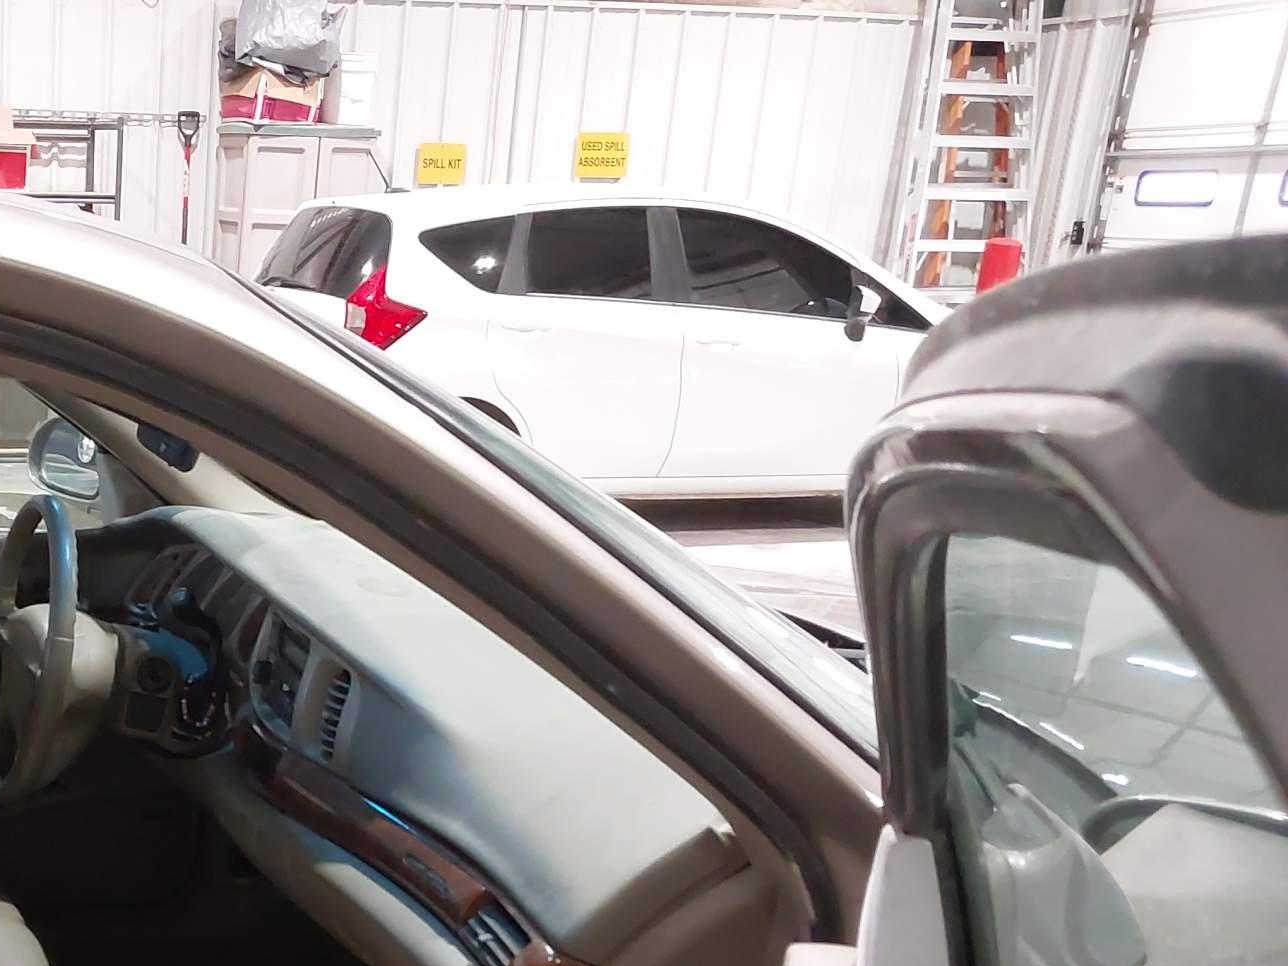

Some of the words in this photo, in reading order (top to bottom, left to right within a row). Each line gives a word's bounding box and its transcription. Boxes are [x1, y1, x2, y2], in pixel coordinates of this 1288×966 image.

[581, 140, 603, 151] USED
[605, 141, 625, 151] SPILL
[422, 158, 446, 169] SPILL
[448, 158, 462, 169] KIT
[578, 156, 627, 168] ABSORBENT
